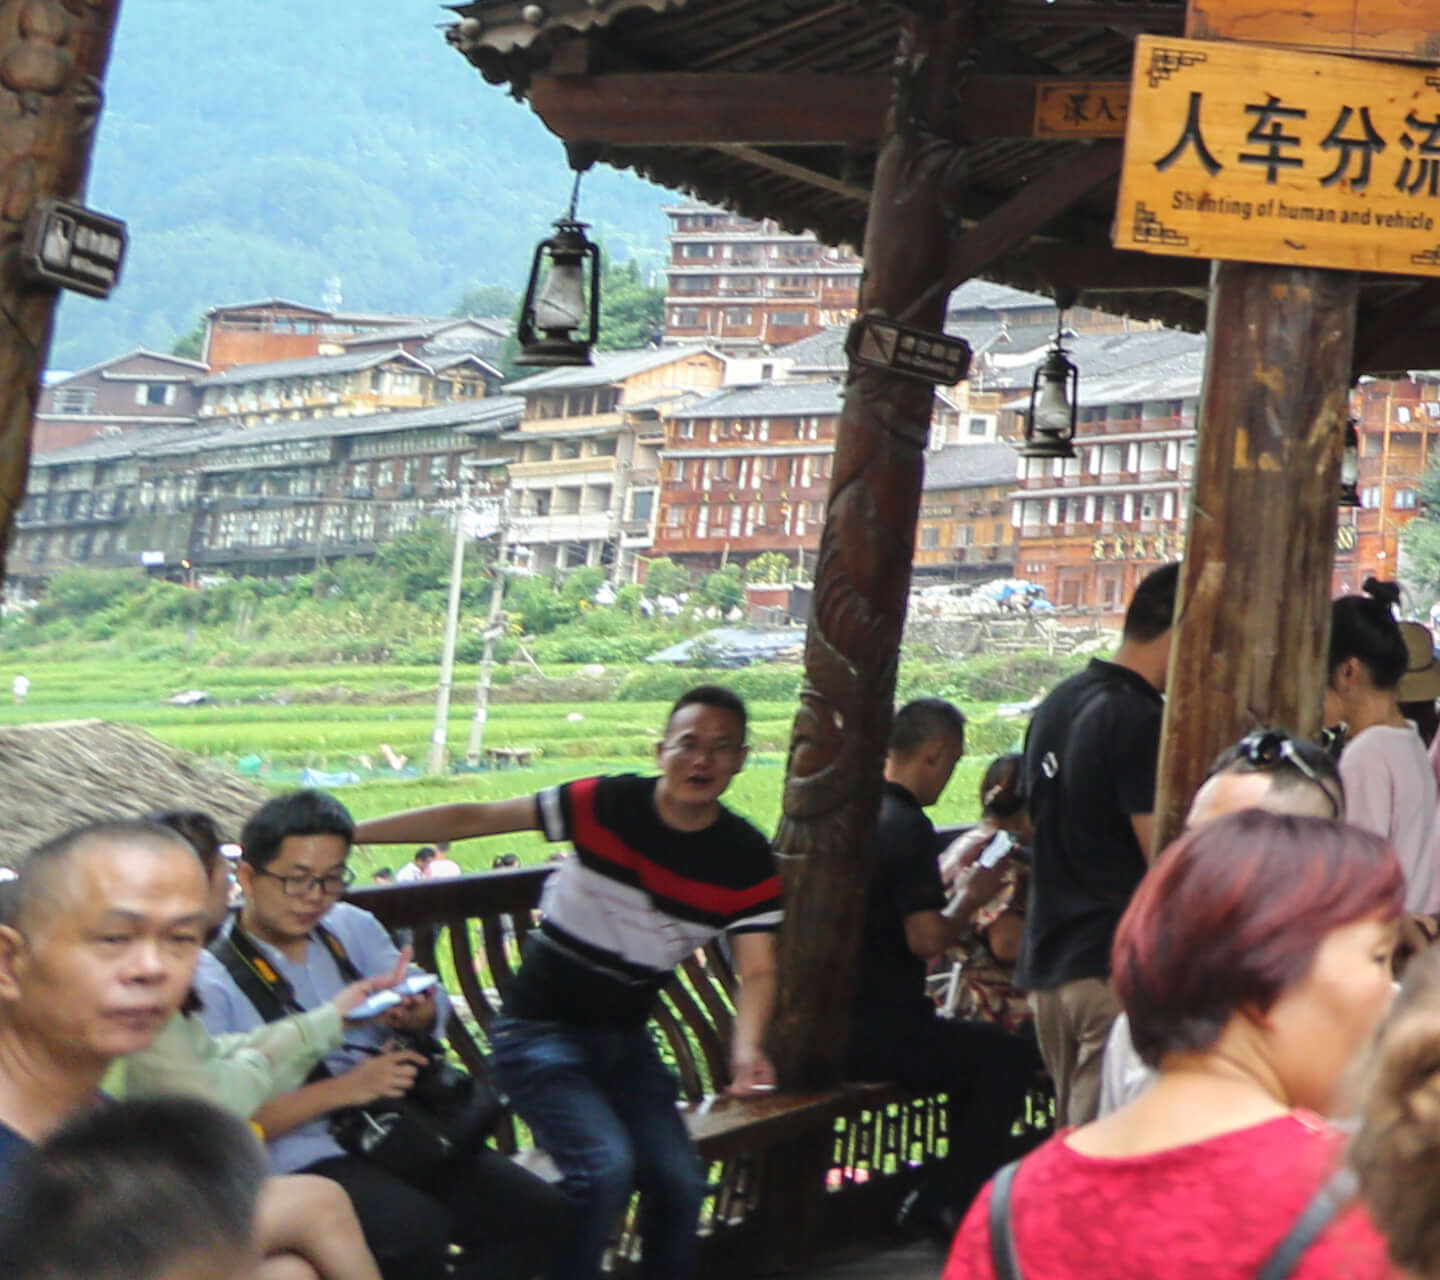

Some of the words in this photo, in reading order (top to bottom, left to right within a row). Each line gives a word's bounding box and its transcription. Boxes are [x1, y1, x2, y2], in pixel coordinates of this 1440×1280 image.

[1171, 190, 1252, 220] Shunting
[1256, 199, 1274, 217] of
[1278, 202, 1335, 223] human
[1339, 207, 1371, 227] and
[1374, 211, 1435, 232] vehicle
